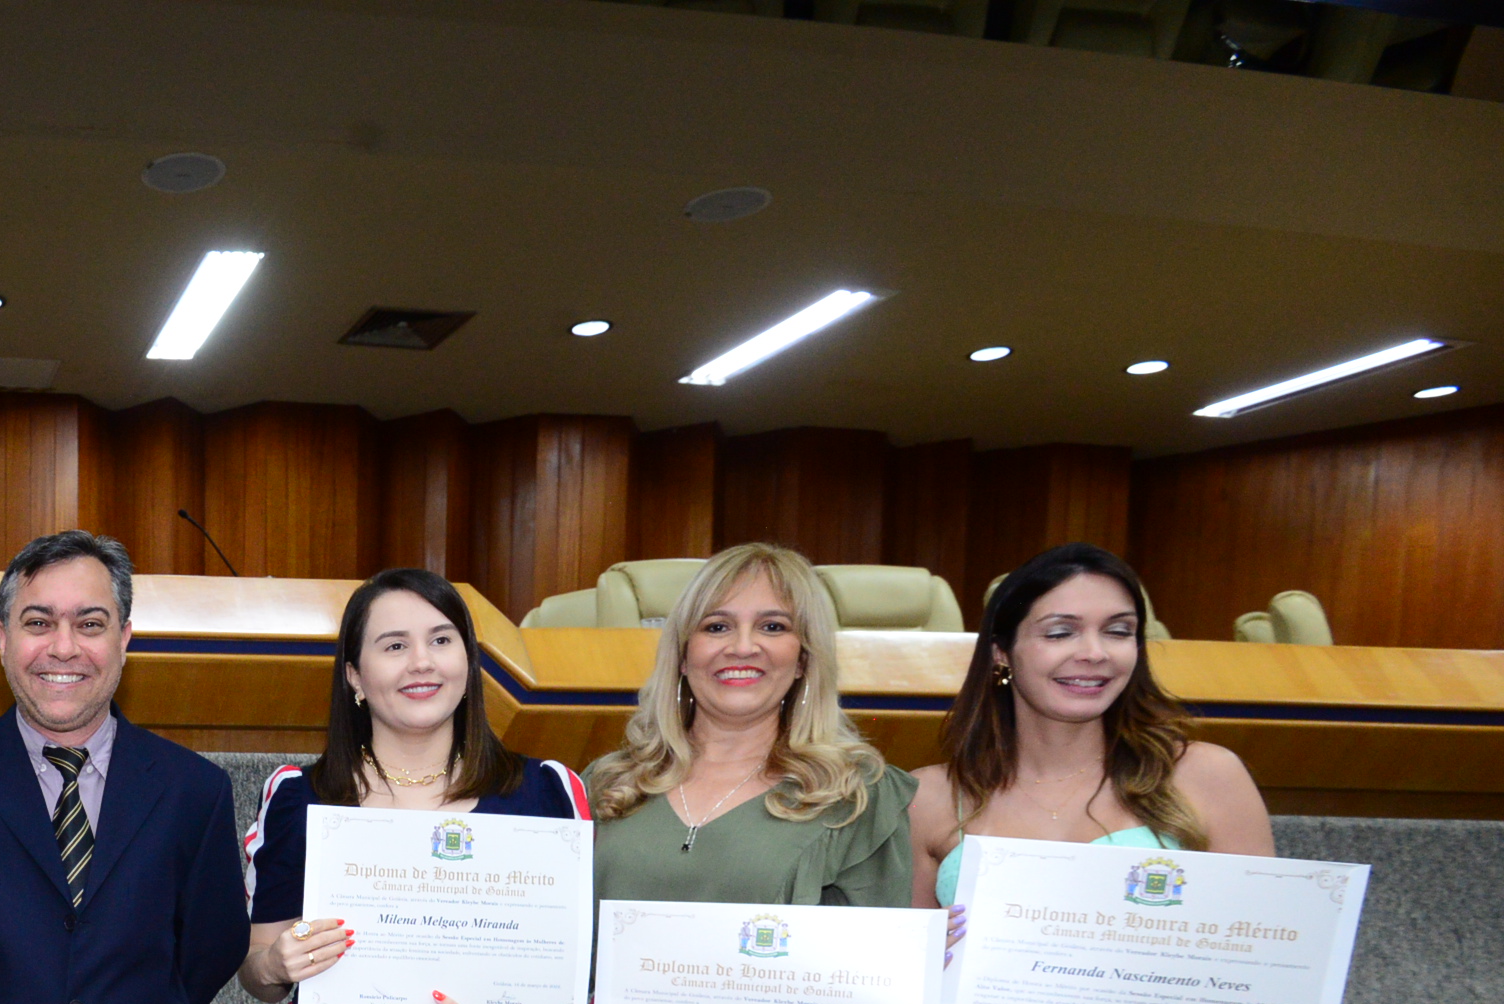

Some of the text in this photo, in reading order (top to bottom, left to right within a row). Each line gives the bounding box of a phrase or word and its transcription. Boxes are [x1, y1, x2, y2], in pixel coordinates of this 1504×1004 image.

[344, 862, 555, 886] Diploma de Honra ao Mérito
[372, 880, 525, 897] Câmara Municipal de Goiânia
[379, 913, 519, 930] Milena Melgaço Miranda
[1005, 903, 1298, 941] Diploma de Honra ao Mérito
[1040, 924, 1252, 953] Câmara Municipal de Goiânia
[639, 957, 891, 986] Diploma de Honra ao Mérito
[1031, 960, 1251, 991] Fernanda Nascimento Neves
[670, 976, 853, 998] Câmara Municipal de Goiânia
